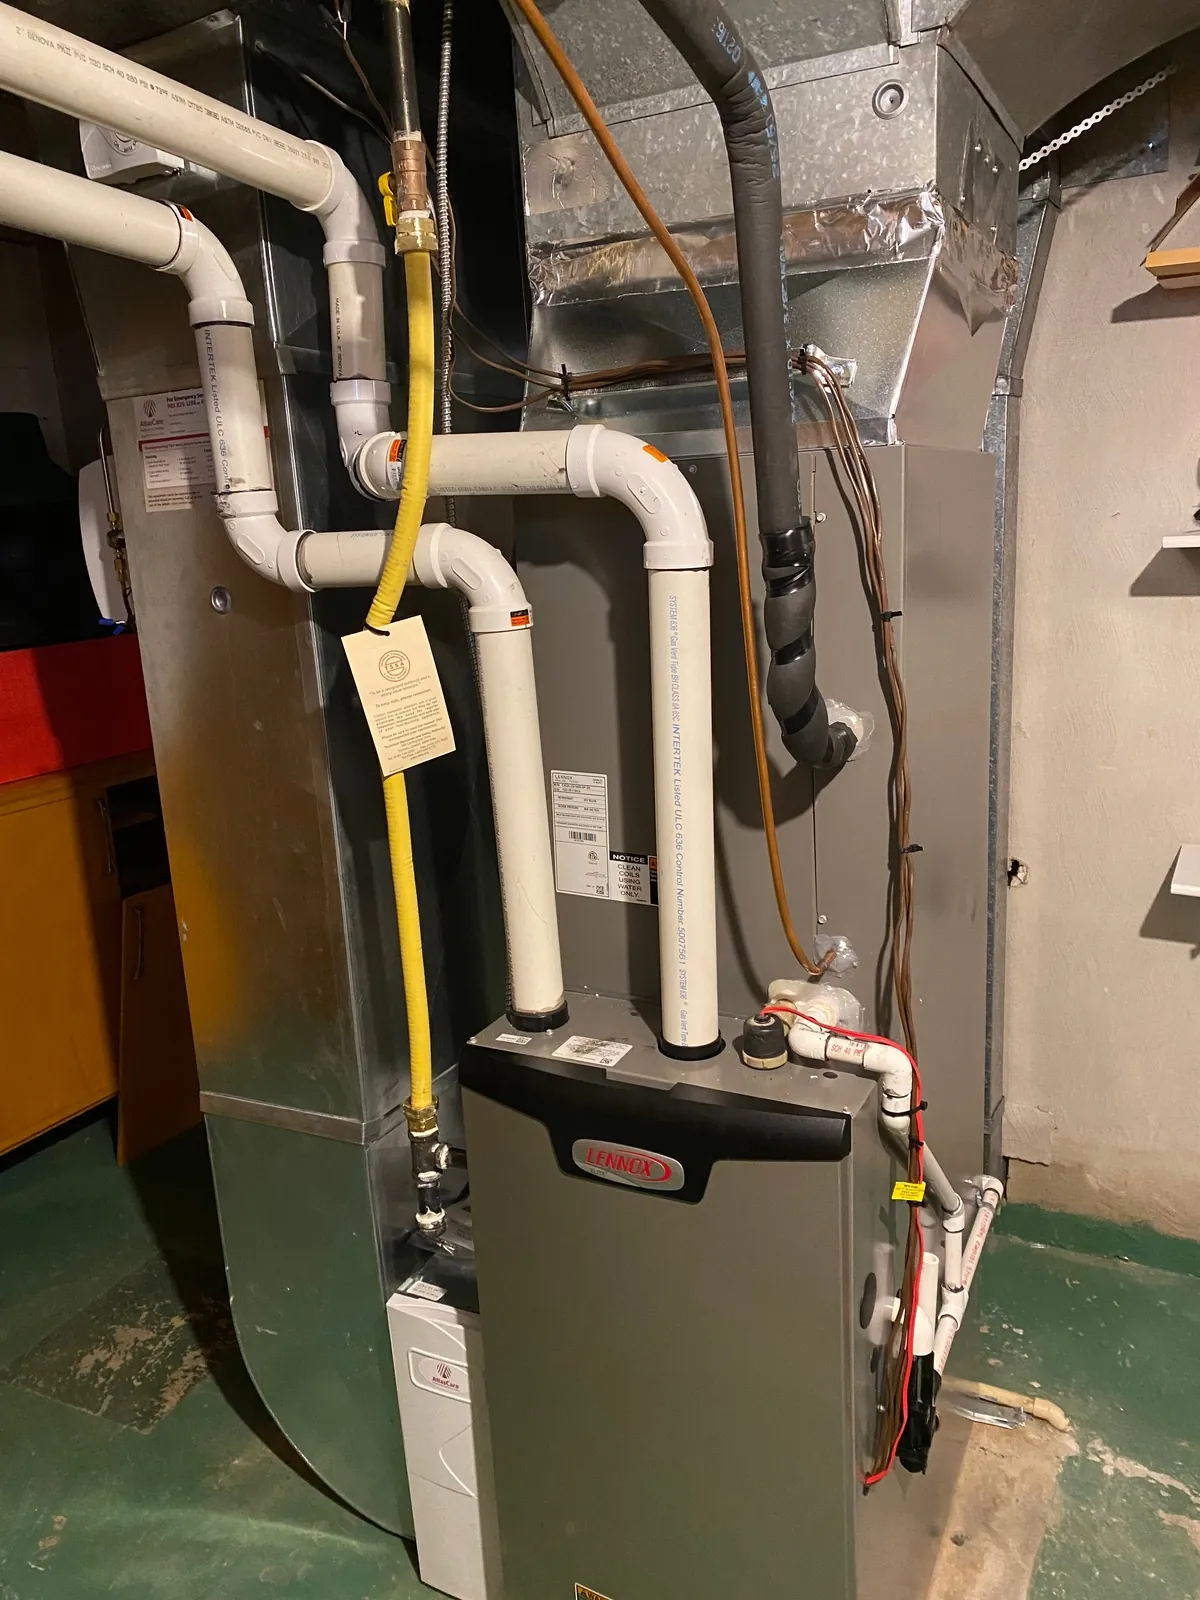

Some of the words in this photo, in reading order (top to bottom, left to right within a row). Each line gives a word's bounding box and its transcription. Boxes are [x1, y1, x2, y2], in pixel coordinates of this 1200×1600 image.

[204, 329, 217, 381] INTERTEK
[211, 384, 221, 413] Listed
[215, 416, 224, 436] ULC
[219, 439, 228, 457] 636
[669, 595, 678, 620] SYSTEM
[670, 621, 678, 631] 636
[671, 661, 679, 673] Type
[671, 674, 679, 683] BH
[672, 683, 680, 702] CLASS
[672, 723, 681, 776] INTERTEK
[674, 778, 682, 807] Listed
[674, 810, 683, 831] ULC
[675, 832, 683, 850] 636
[612, 854, 646, 863] NOTICE
[617, 864, 641, 872] CLEAN
[675, 852, 684, 886] Control
[617, 883, 642, 892] WATER
[618, 877, 641, 885] USING
[676, 888, 685, 924] Number
[677, 926, 686, 965] 5007561
[585, 1147, 654, 1177] LENNOX
